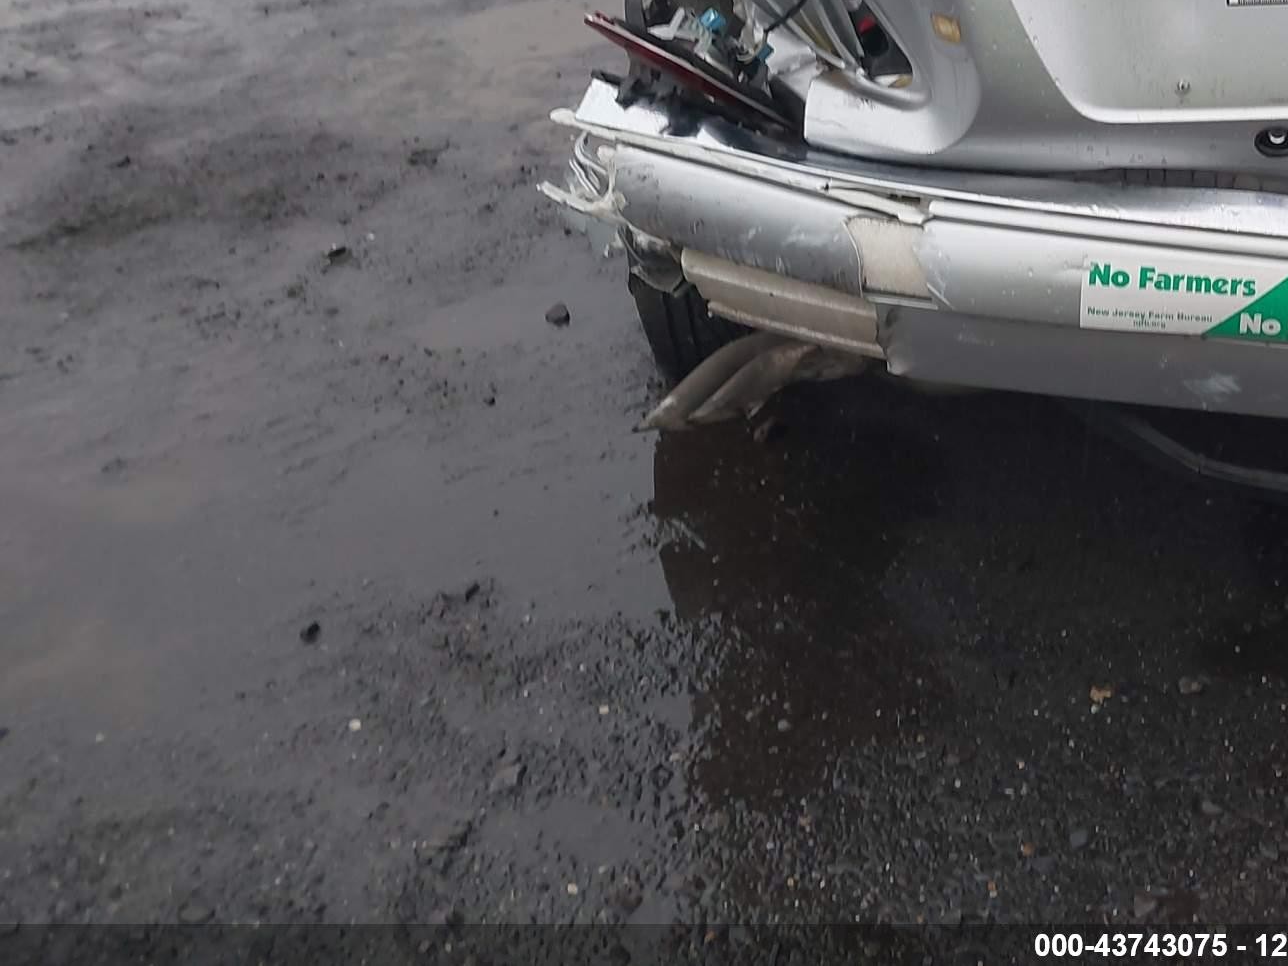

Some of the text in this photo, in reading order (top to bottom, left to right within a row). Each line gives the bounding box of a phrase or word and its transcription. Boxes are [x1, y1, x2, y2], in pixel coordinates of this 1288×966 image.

[1088, 262, 1257, 297] No Farmers
[1087, 307, 1213, 322] New Jersey Farm Bureau
[1239, 312, 1281, 336] No
